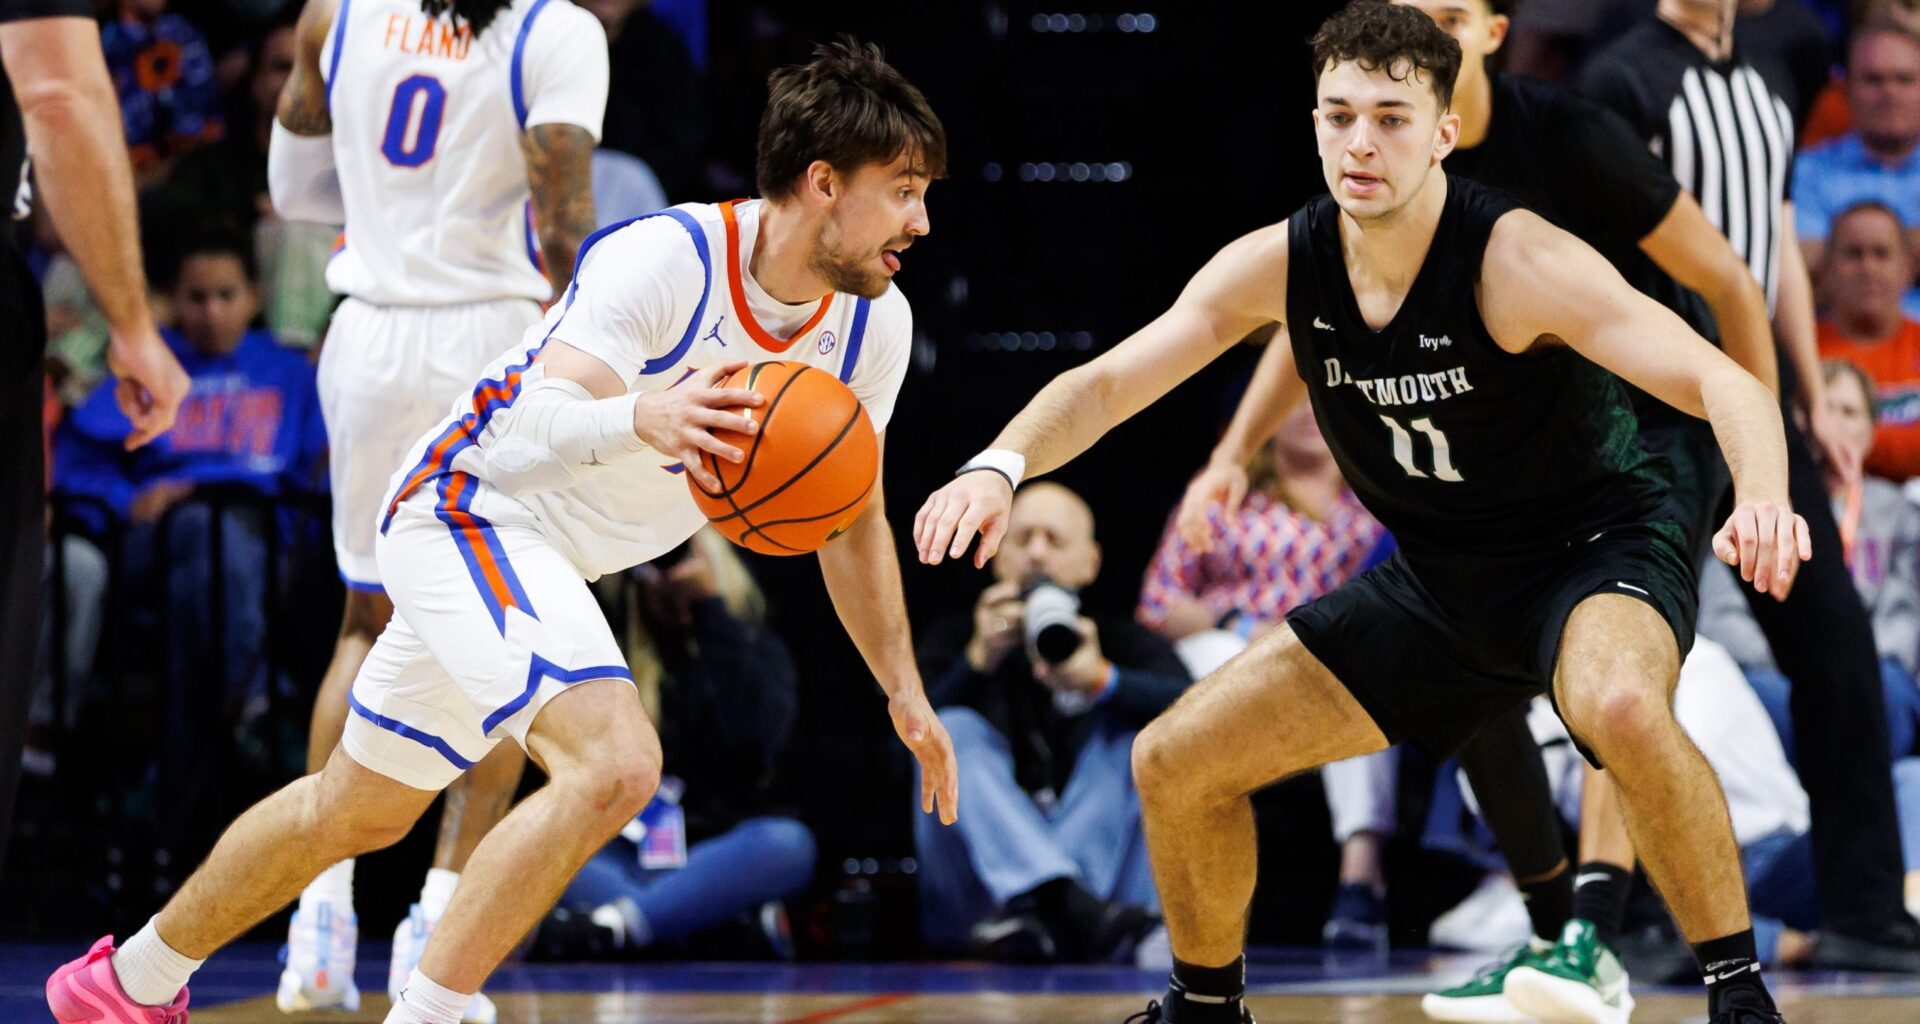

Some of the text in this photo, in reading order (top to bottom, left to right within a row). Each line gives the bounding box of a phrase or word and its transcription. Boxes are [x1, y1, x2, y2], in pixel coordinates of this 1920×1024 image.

[384, 13, 473, 60] FLAND
[380, 73, 448, 169] 0
[1419, 334, 1439, 351] Ivy
[1324, 357, 1474, 406] DTMOUTH
[1379, 414, 1465, 482] 11
